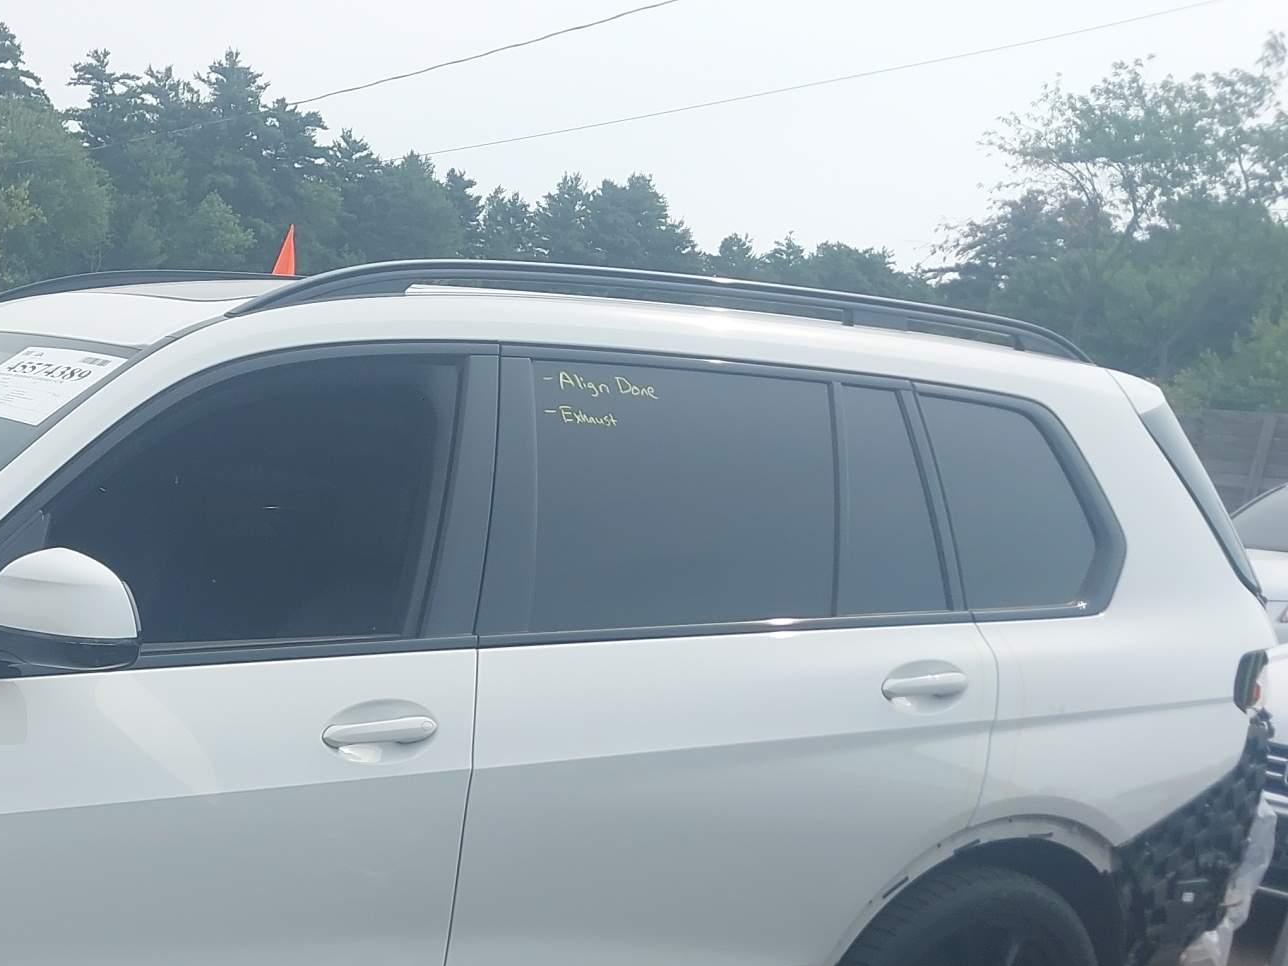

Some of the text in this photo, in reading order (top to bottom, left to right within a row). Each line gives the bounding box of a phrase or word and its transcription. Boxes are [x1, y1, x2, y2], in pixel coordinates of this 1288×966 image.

[7, 360, 92, 382] 45574389
[559, 371, 610, 397] Align
[614, 376, 659, 400] Done
[559, 405, 618, 427] Exhaust
